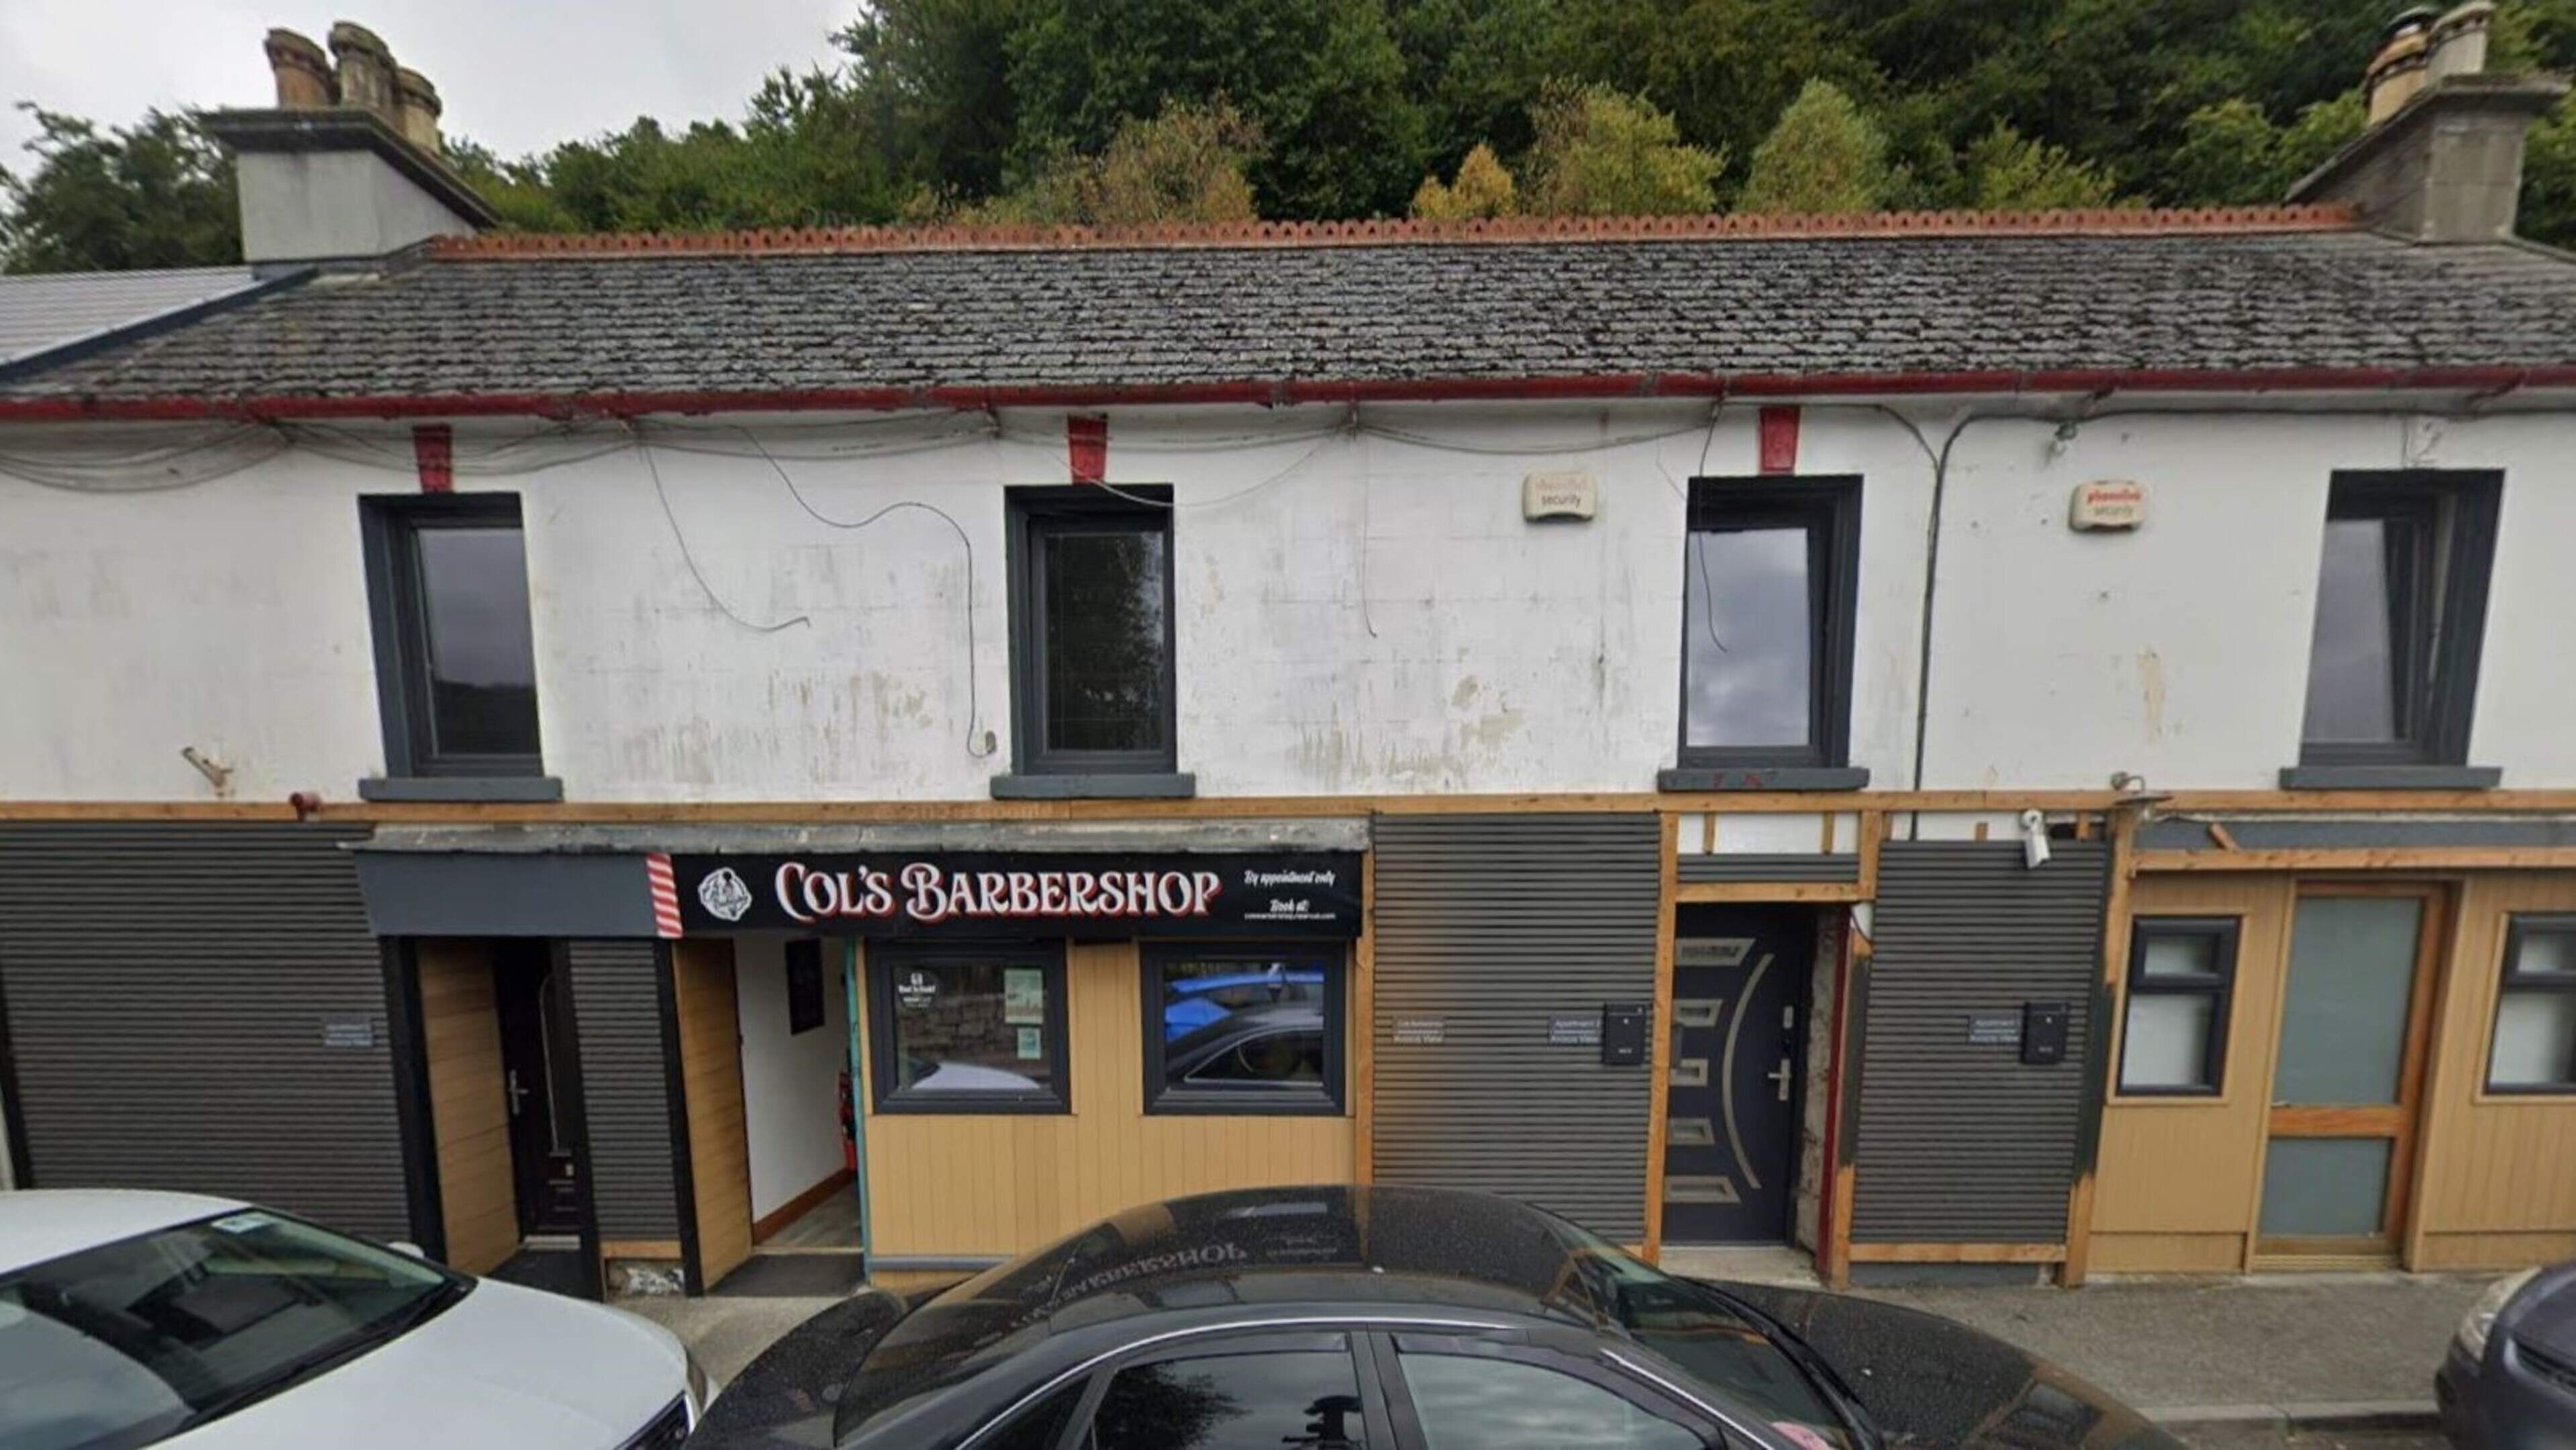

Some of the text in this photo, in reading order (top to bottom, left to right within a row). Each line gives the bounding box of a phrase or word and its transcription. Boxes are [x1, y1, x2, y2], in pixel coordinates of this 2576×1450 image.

[1541, 494, 1581, 509] security
[1260, 869, 1315, 887] appointment
[1315, 870, 1336, 887] only
[900, 862, 1224, 923] BARBERSHOP
